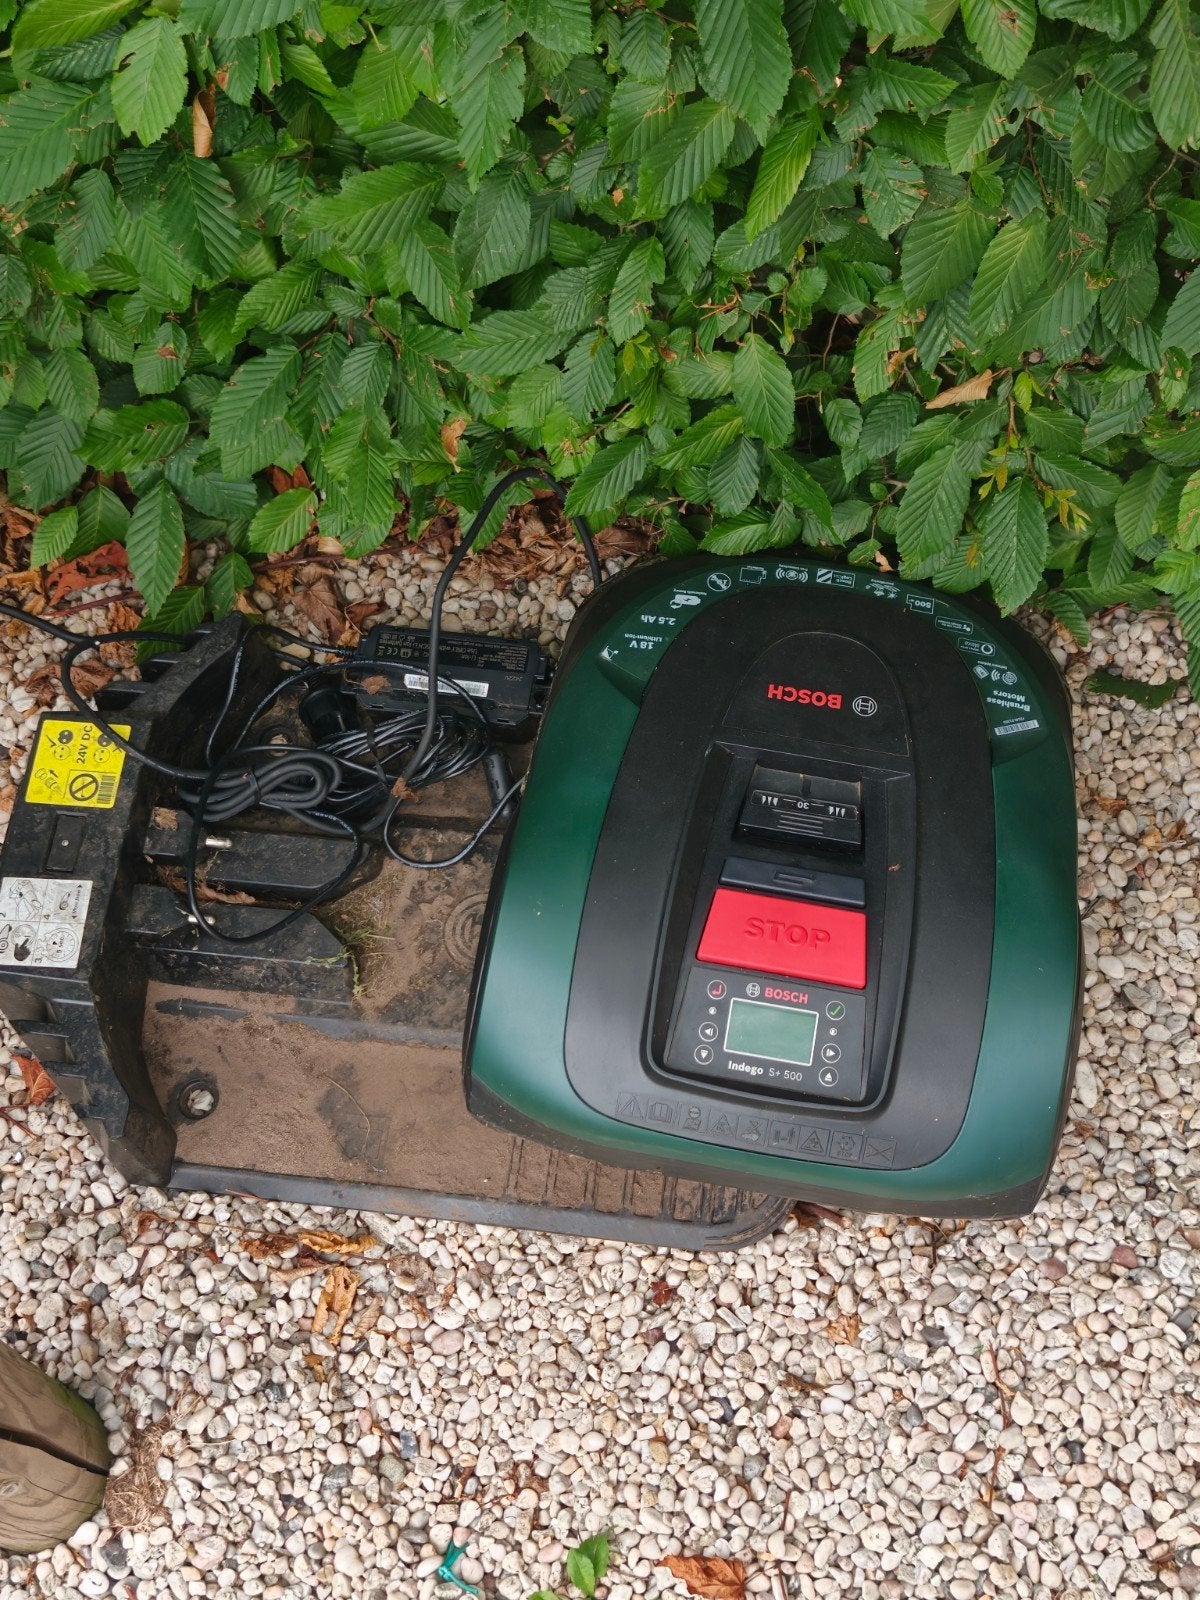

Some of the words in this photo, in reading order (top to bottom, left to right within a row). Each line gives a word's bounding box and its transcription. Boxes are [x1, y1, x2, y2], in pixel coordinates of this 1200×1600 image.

[914, 600, 932, 609] 500
[640, 614, 656, 625] Ah
[658, 616, 676, 626] 2.5
[629, 640, 639, 649] V
[640, 641, 654, 650] 18
[767, 684, 843, 710] BOSCH
[993, 690, 1026, 702] Motors
[986, 697, 1031, 712] Brushless
[82, 725, 93, 741] DC
[76, 744, 89, 765] 24V
[797, 801, 810, 809] 30
[744, 917, 831, 950] STOP
[764, 987, 809, 1004] BOSCH
[728, 1060, 764, 1076] Indego
[768, 1067, 781, 1077] S+
[783, 1069, 803, 1082] 500
